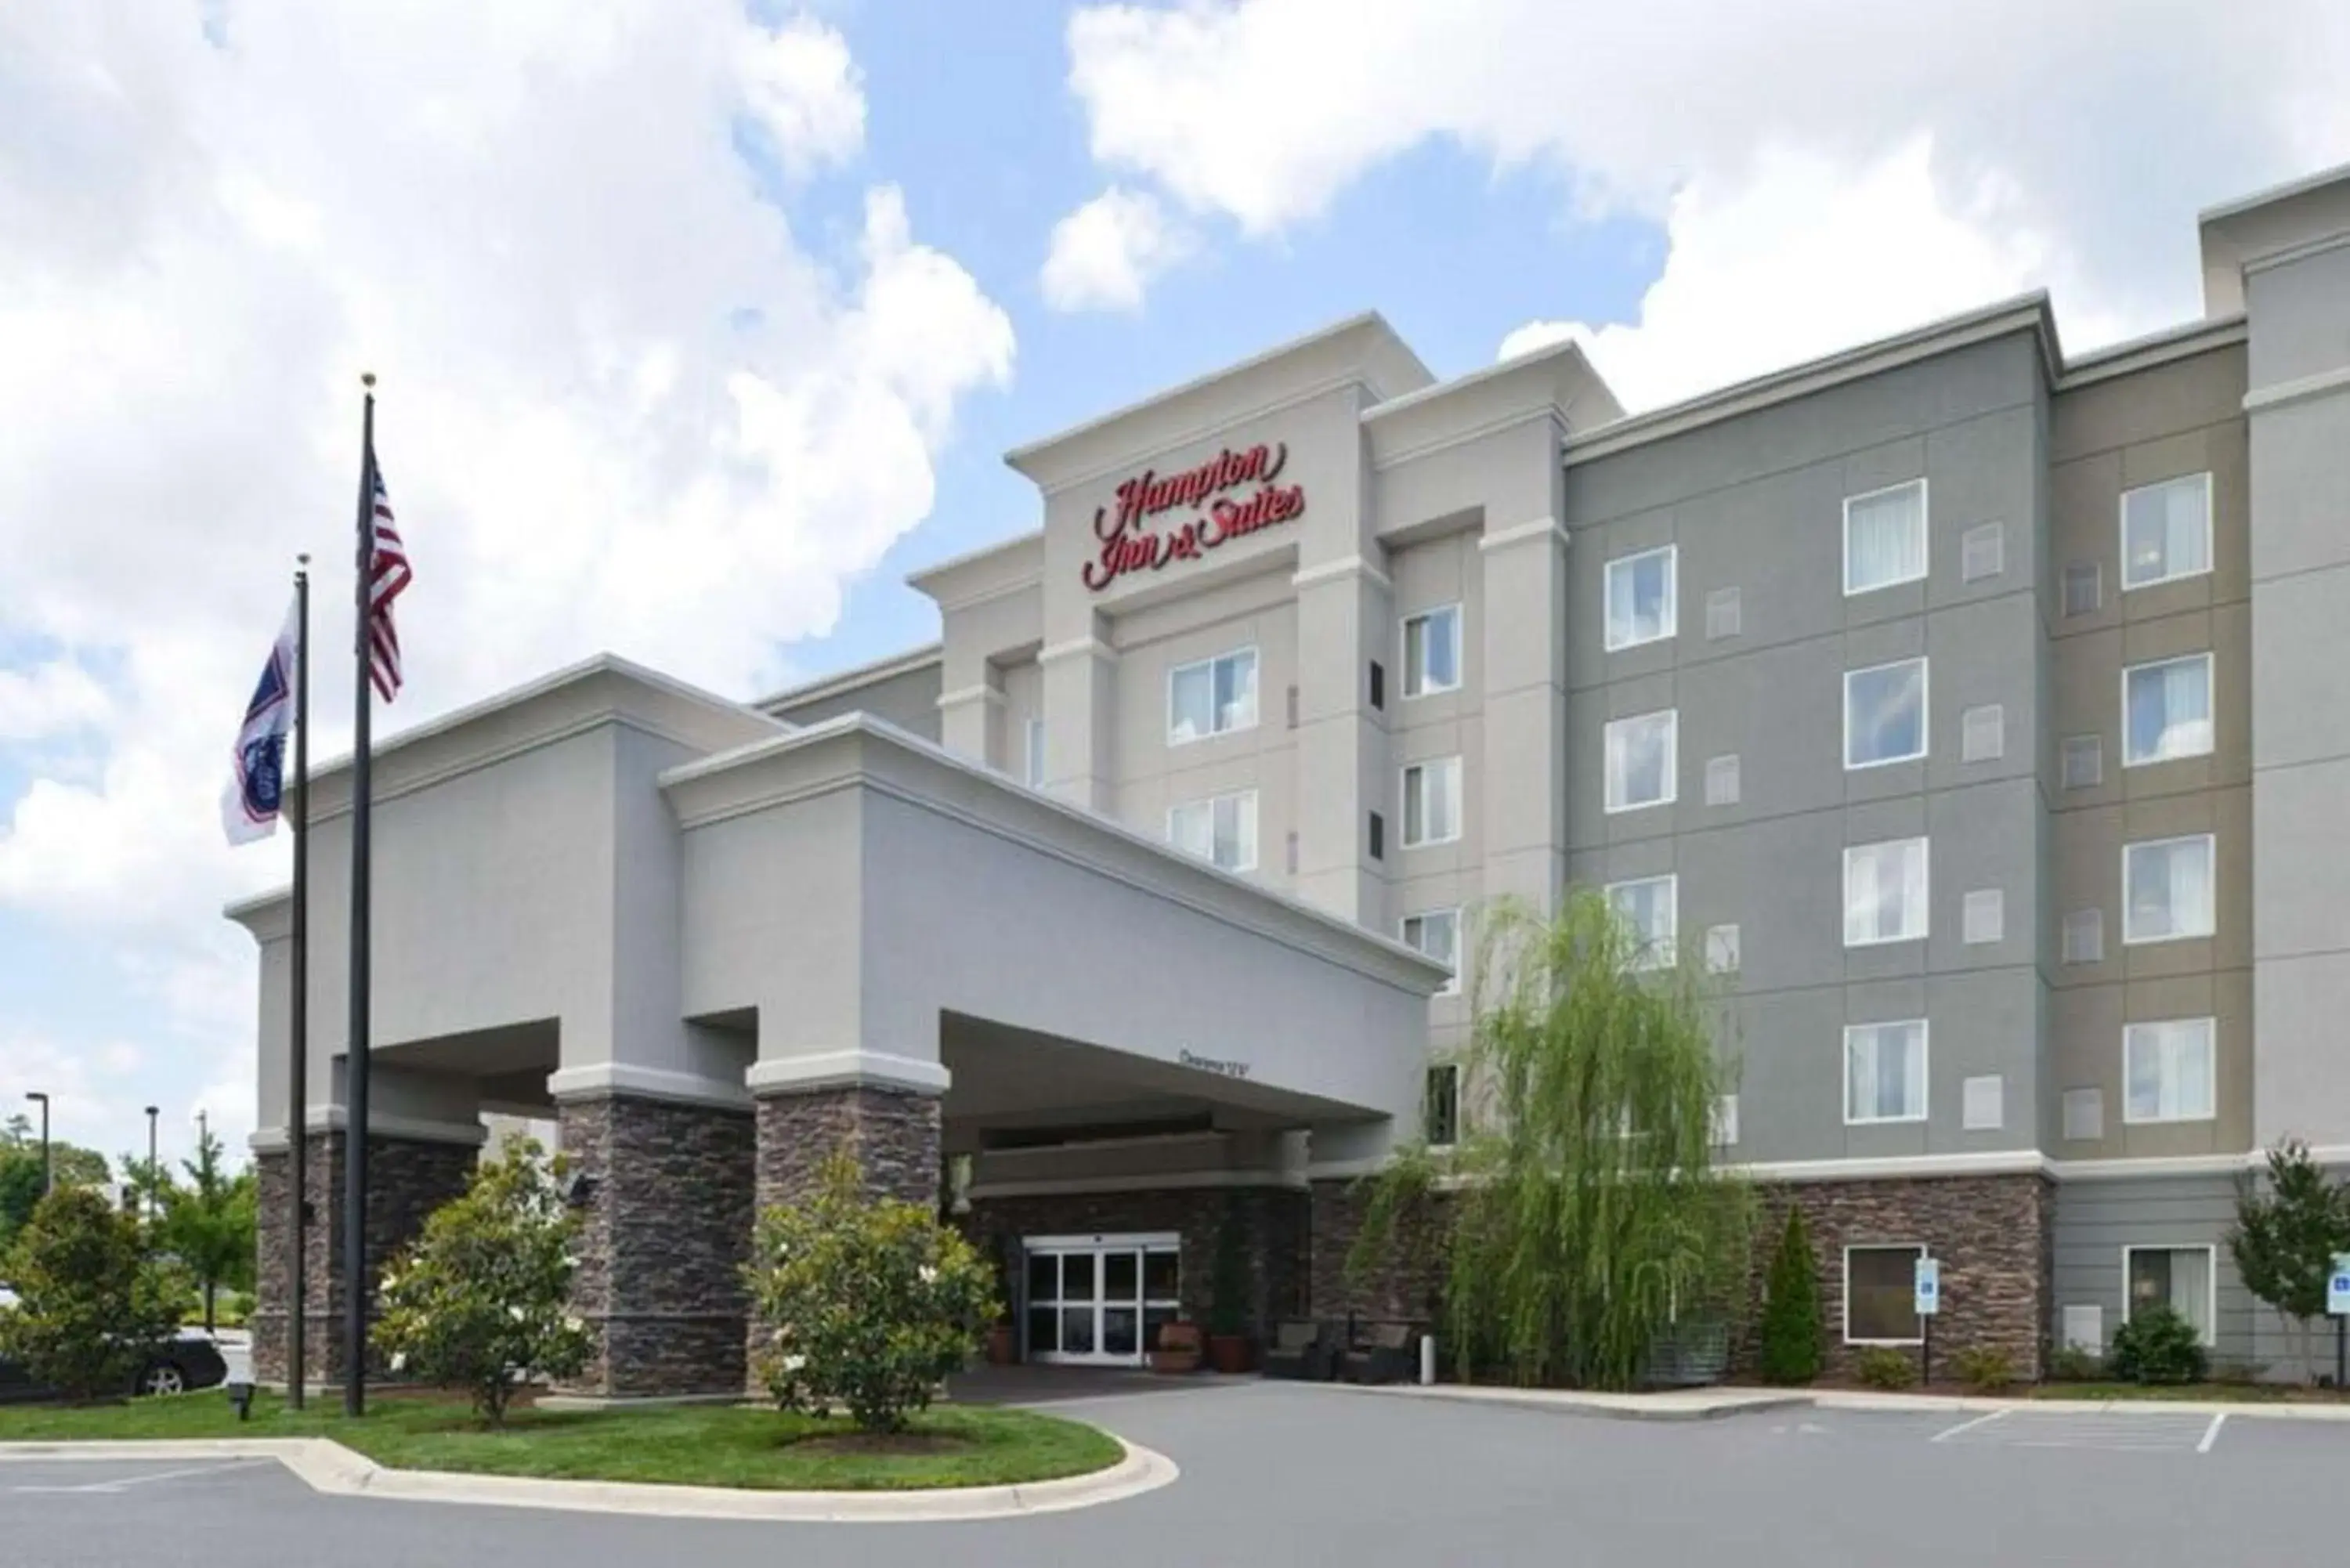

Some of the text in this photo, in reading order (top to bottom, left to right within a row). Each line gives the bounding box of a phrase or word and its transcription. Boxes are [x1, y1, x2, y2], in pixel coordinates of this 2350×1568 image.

[1083, 484, 1305, 591] Inn & Suites
[1094, 443, 1287, 540] Hampton
